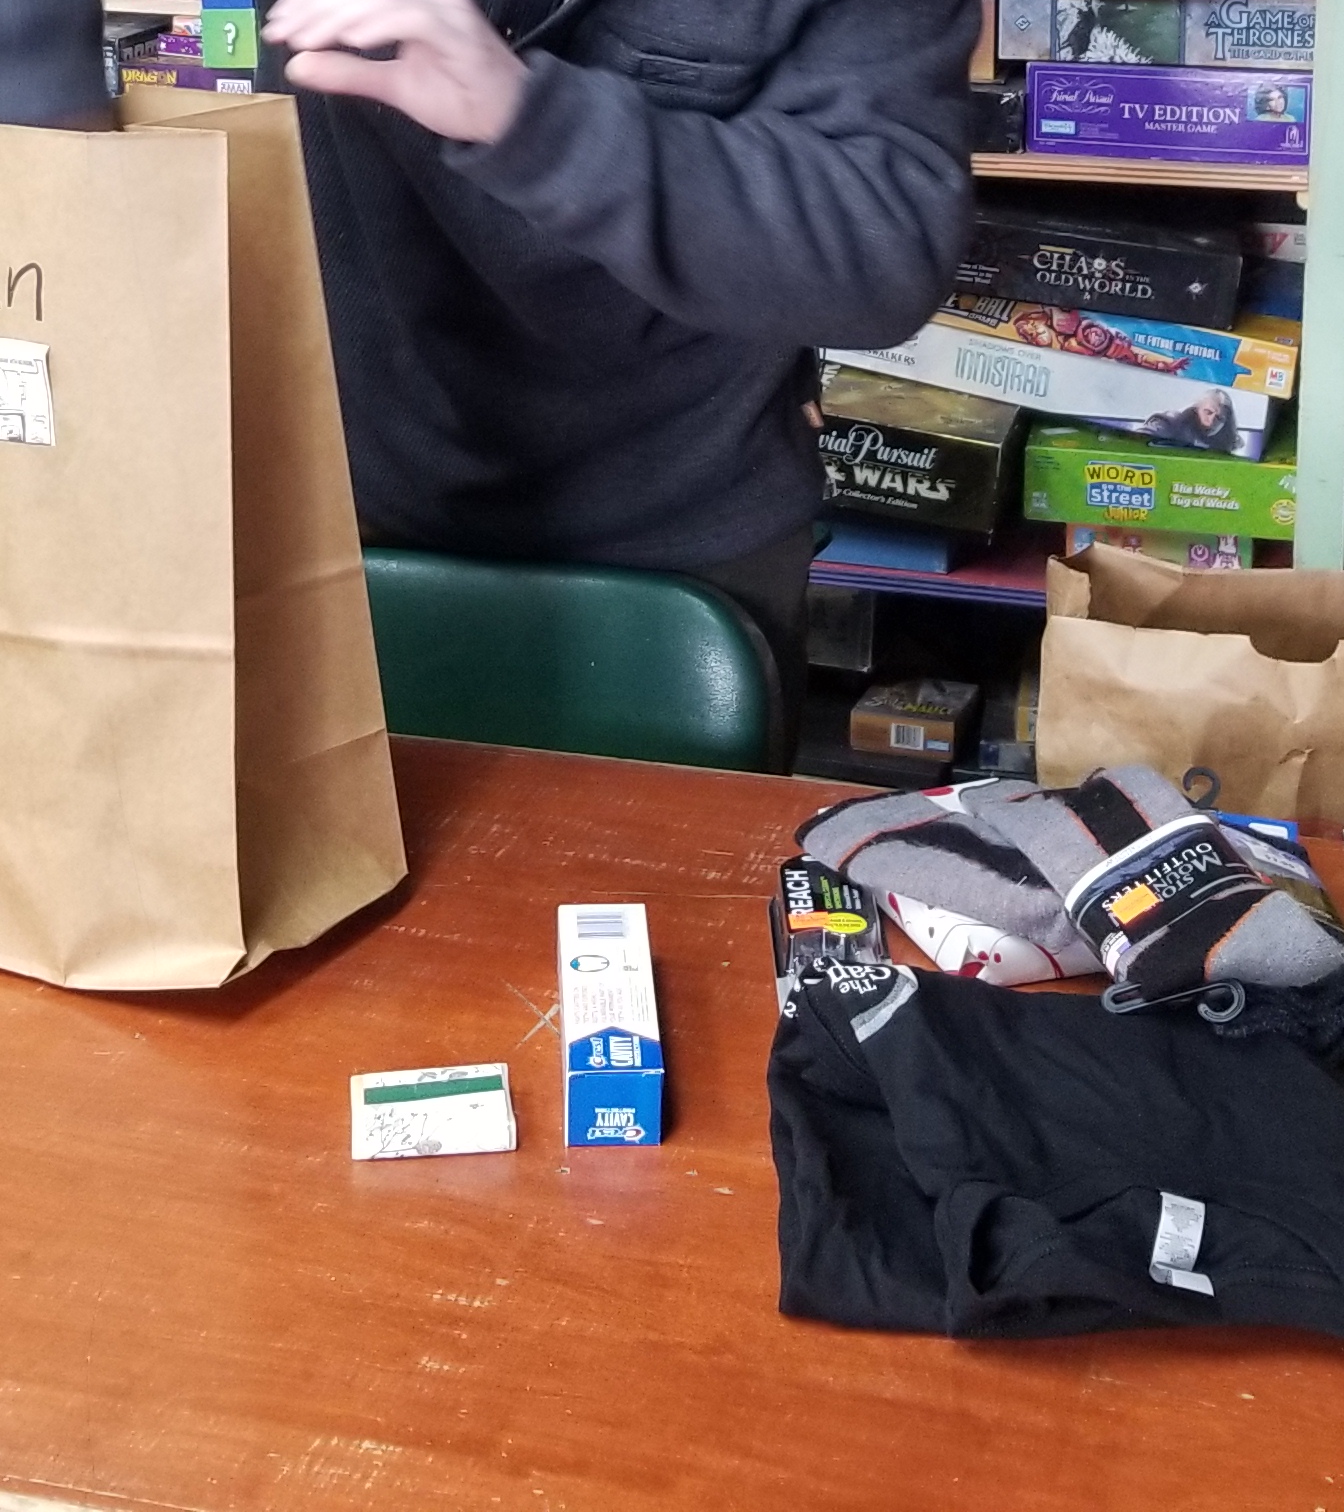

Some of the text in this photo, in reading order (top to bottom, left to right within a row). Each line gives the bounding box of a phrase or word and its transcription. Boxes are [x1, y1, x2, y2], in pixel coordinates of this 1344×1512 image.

[1205, 10, 1219, 27] A
[1206, 27, 1316, 61] THRONES
[1120, 103, 1242, 124] TV EDITION
[1145, 122, 1218, 134] MASTER GAME
[1032, 250, 1125, 280] CHAOS
[1036, 270, 1074, 287] OLD
[969, 339, 1042, 361] SHADOWS OVER
[1134, 333, 1222, 361] THE FUTURE FOOTBALL
[955, 347, 1052, 398] INNISTRAD
[842, 424, 938, 470] Pursuit
[854, 464, 957, 501] WARS
[1086, 466, 1154, 486] WORD
[1090, 488, 1151, 507] Street
[1172, 482, 1230, 499] The Wacky
[887, 497, 919, 510] Edition
[1170, 494, 1241, 511] Tug of Words
[1104, 506, 1147, 521] JUNIOR
[784, 868, 815, 917] REACH
[826, 963, 893, 991] Gap
[838, 978, 879, 995] The
[608, 1035, 634, 1067] CAVITY
[595, 1111, 635, 1127] CAVITY
